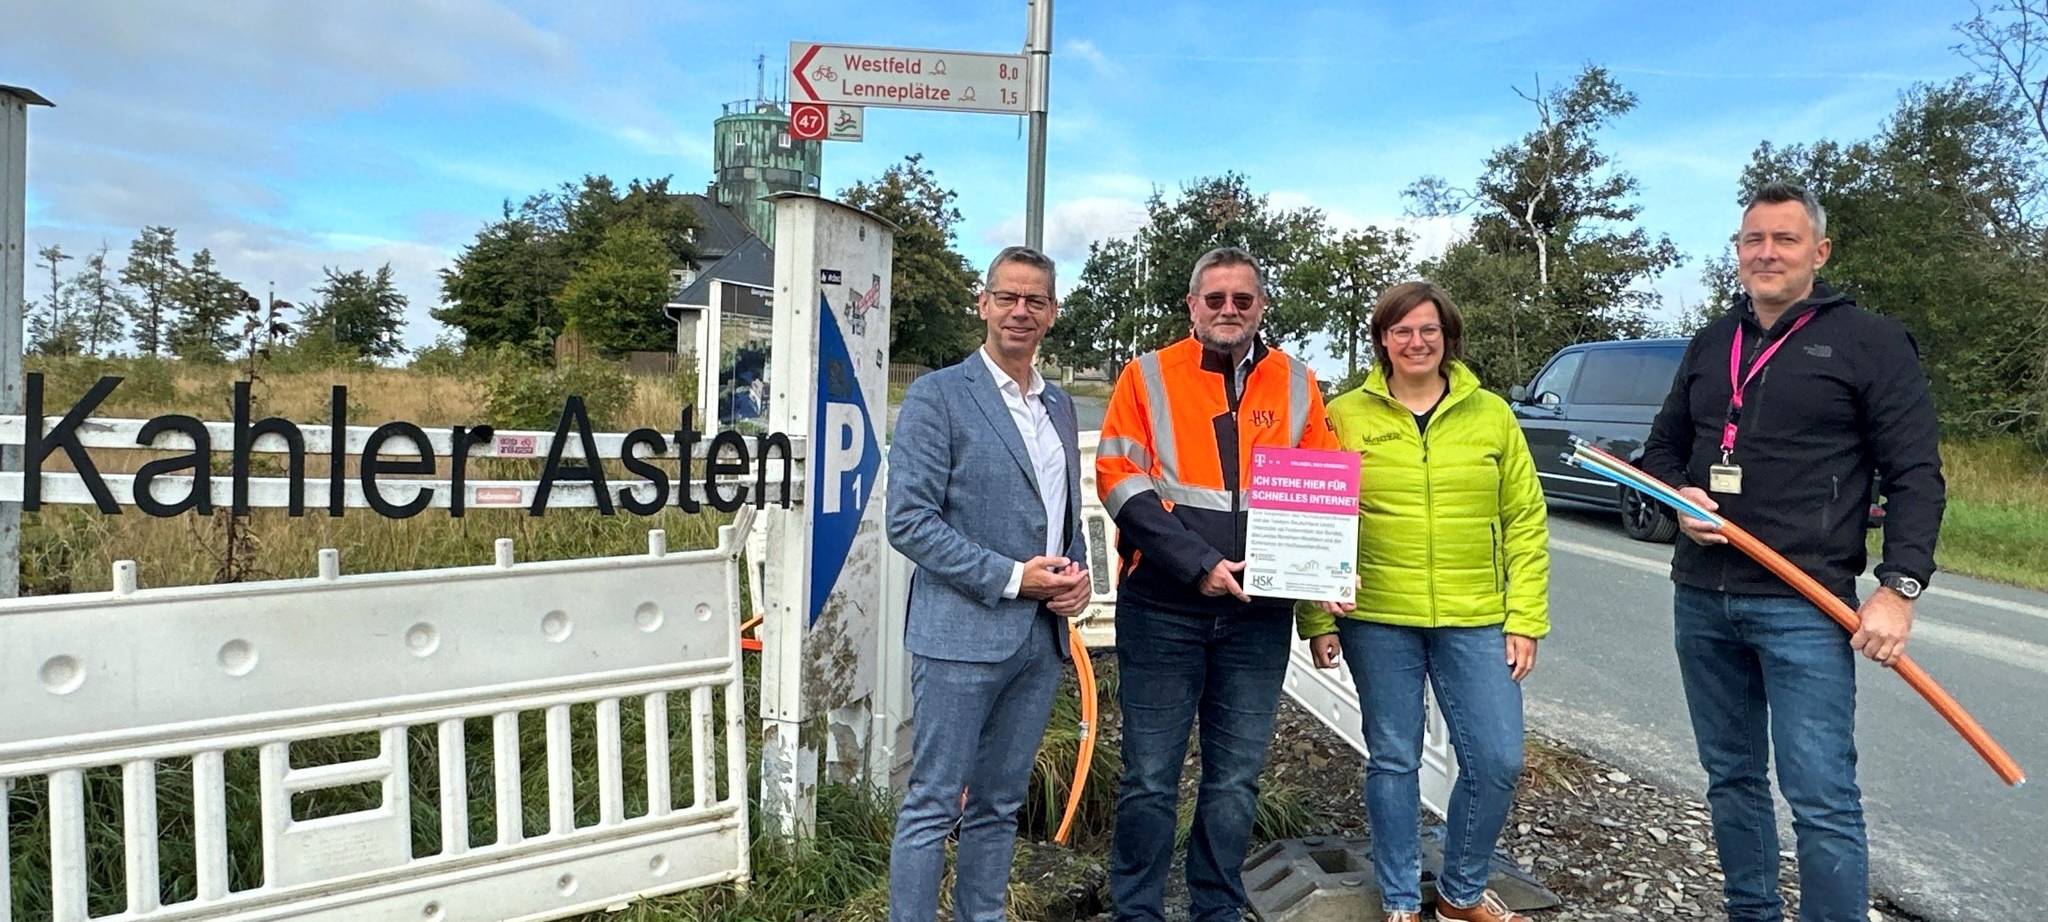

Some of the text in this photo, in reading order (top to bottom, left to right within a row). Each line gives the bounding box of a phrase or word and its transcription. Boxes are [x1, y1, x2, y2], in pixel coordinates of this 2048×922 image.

[844, 54, 921, 74] Westfeld
[842, 80, 950, 102] Lenneplätze
[798, 115, 819, 128] 47
[24, 372, 791, 519] Kahler Asten
[822, 401, 865, 514] P
[1253, 475, 1347, 491] ICH STEHE HIER FÜR
[1252, 489, 1357, 507] SCHNELLES INTERNET
[1253, 575, 1273, 586] HSK
